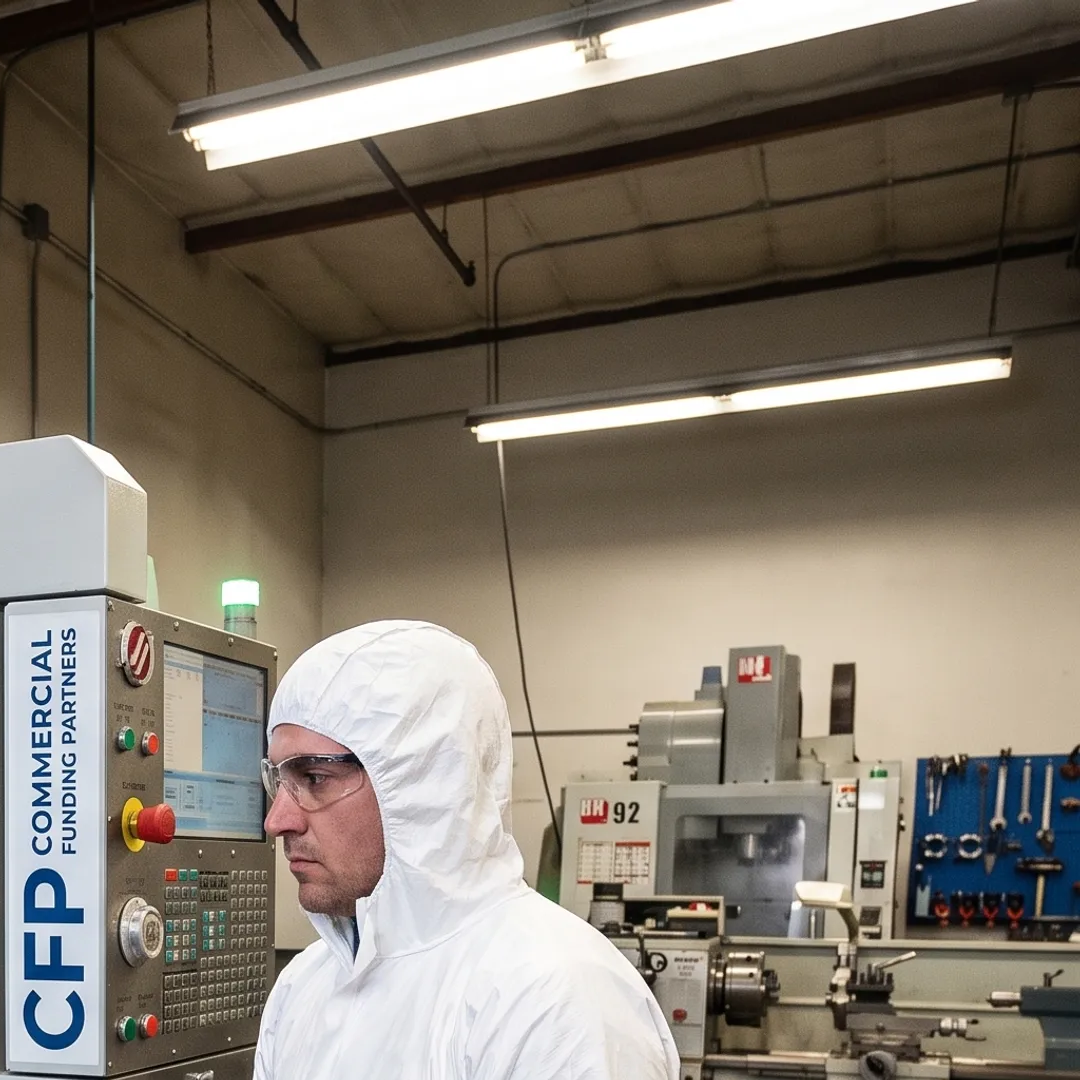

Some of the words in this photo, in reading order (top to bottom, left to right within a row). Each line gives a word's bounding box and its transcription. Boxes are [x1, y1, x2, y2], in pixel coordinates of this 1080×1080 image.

[31, 631, 52, 856] COMMERCIAL
[62, 627, 77, 745] PARTNERS
[62, 754, 77, 855] FUNDING
[613, 802, 640, 824] 92
[23, 867, 85, 1051] CFP
